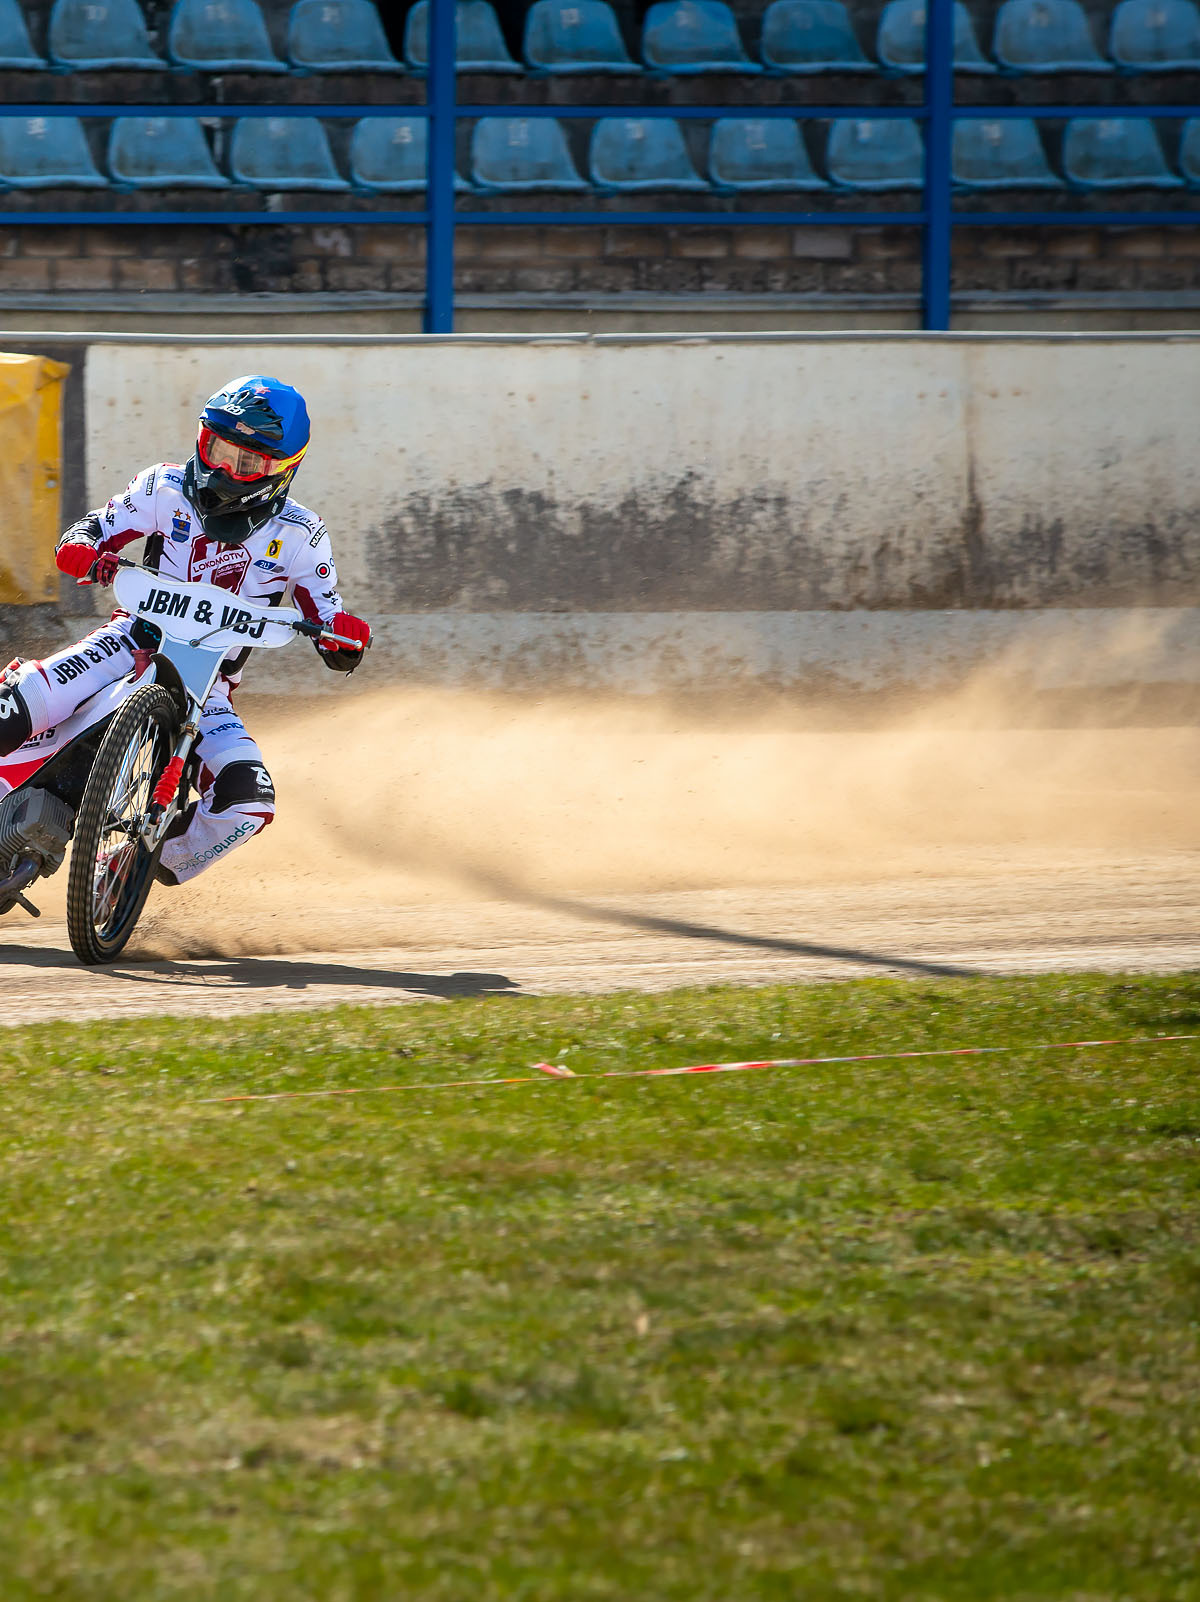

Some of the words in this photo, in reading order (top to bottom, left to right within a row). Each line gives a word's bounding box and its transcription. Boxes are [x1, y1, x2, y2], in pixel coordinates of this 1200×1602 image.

[193, 552, 245, 573] LOKOMOTIV
[138, 588, 192, 618] JBM
[194, 600, 215, 625] &
[220, 605, 268, 639] VBJ
[52, 654, 91, 685] JBM
[83, 648, 105, 664] &
[174, 821, 256, 873] Spartalogistics
